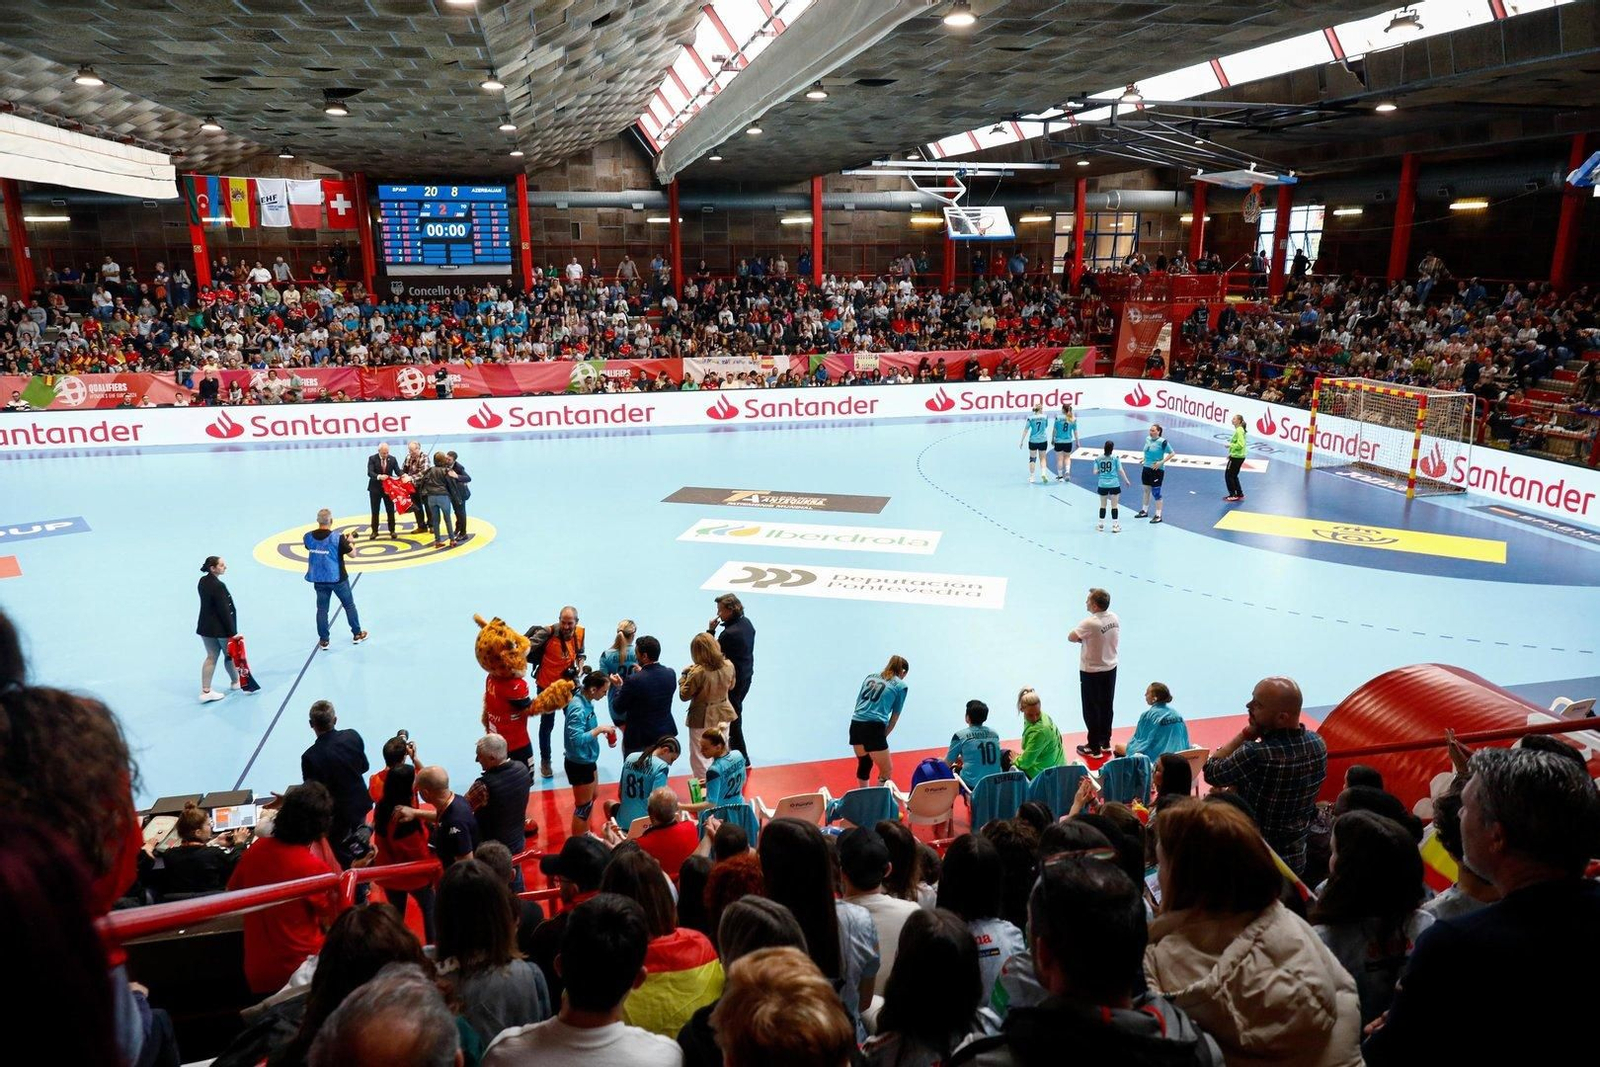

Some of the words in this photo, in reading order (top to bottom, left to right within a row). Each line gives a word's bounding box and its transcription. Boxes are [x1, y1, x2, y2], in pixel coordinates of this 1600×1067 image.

[261, 194, 278, 203] EHF
[424, 186, 438, 196] 20
[451, 186, 458, 197] 8
[439, 204, 447, 215] 2
[426, 223, 466, 237] 00:00
[408, 286, 450, 296] Concello
[453, 286, 466, 296] do
[89, 383, 128, 393] QUALIFIERS
[745, 396, 879, 418] Santander
[961, 389, 1083, 410] Santander
[1156, 390, 1229, 424] Santander
[251, 412, 411, 437] Santander
[509, 404, 655, 428] Santander
[1036, 422, 1042, 432] 7
[1063, 422, 1068, 432] 8
[1279, 417, 1380, 461] Santander
[1100, 461, 1112, 473] 99
[1450, 456, 1596, 515] Santander
[0, 522, 73, 537] UP
[765, 529, 929, 547] Iberdrola
[827, 581, 982, 597] Pontevedra
[861, 679, 886, 703] 20
[977, 741, 997, 766] 10
[626, 773, 645, 799] 81
[724, 773, 743, 800] 22
